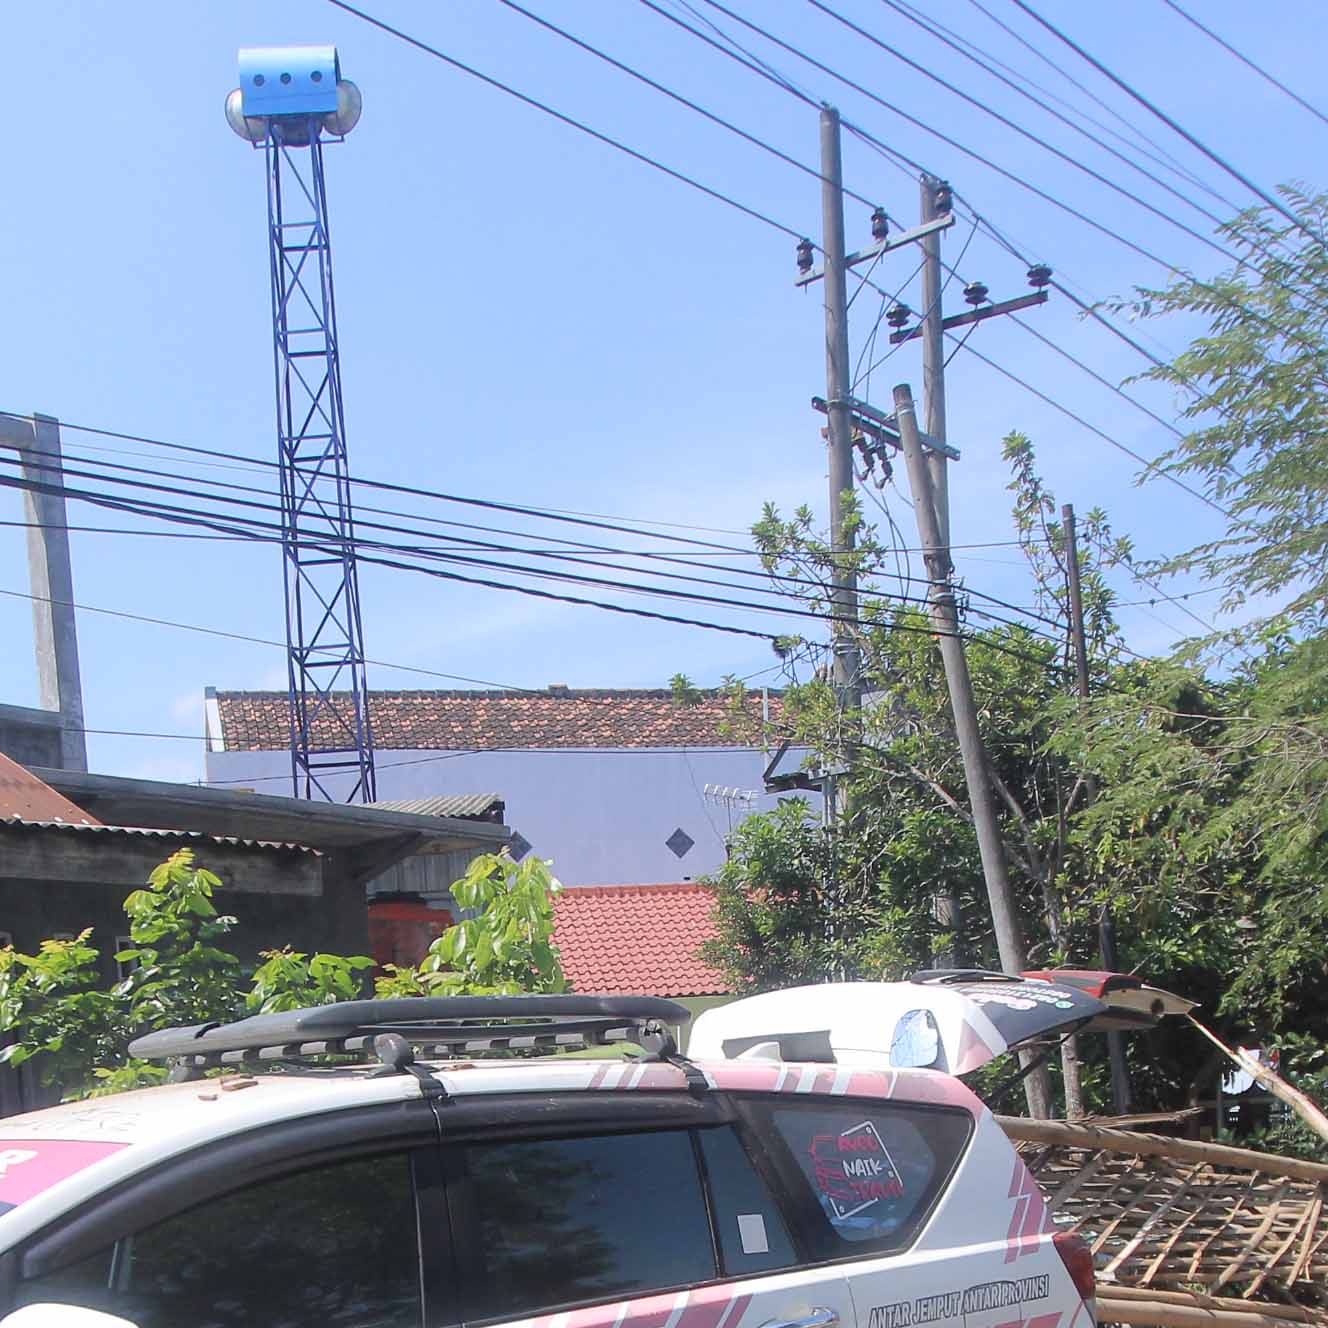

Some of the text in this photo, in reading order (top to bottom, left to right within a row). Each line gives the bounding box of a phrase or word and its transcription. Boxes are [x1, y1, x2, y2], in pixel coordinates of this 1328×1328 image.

[842, 1157, 883, 1178] NAIK
[911, 1291, 961, 1325] JEMPUT
[960, 1282, 1000, 1316] ANTAR
[1000, 1274, 1050, 1307] PROVINSI
